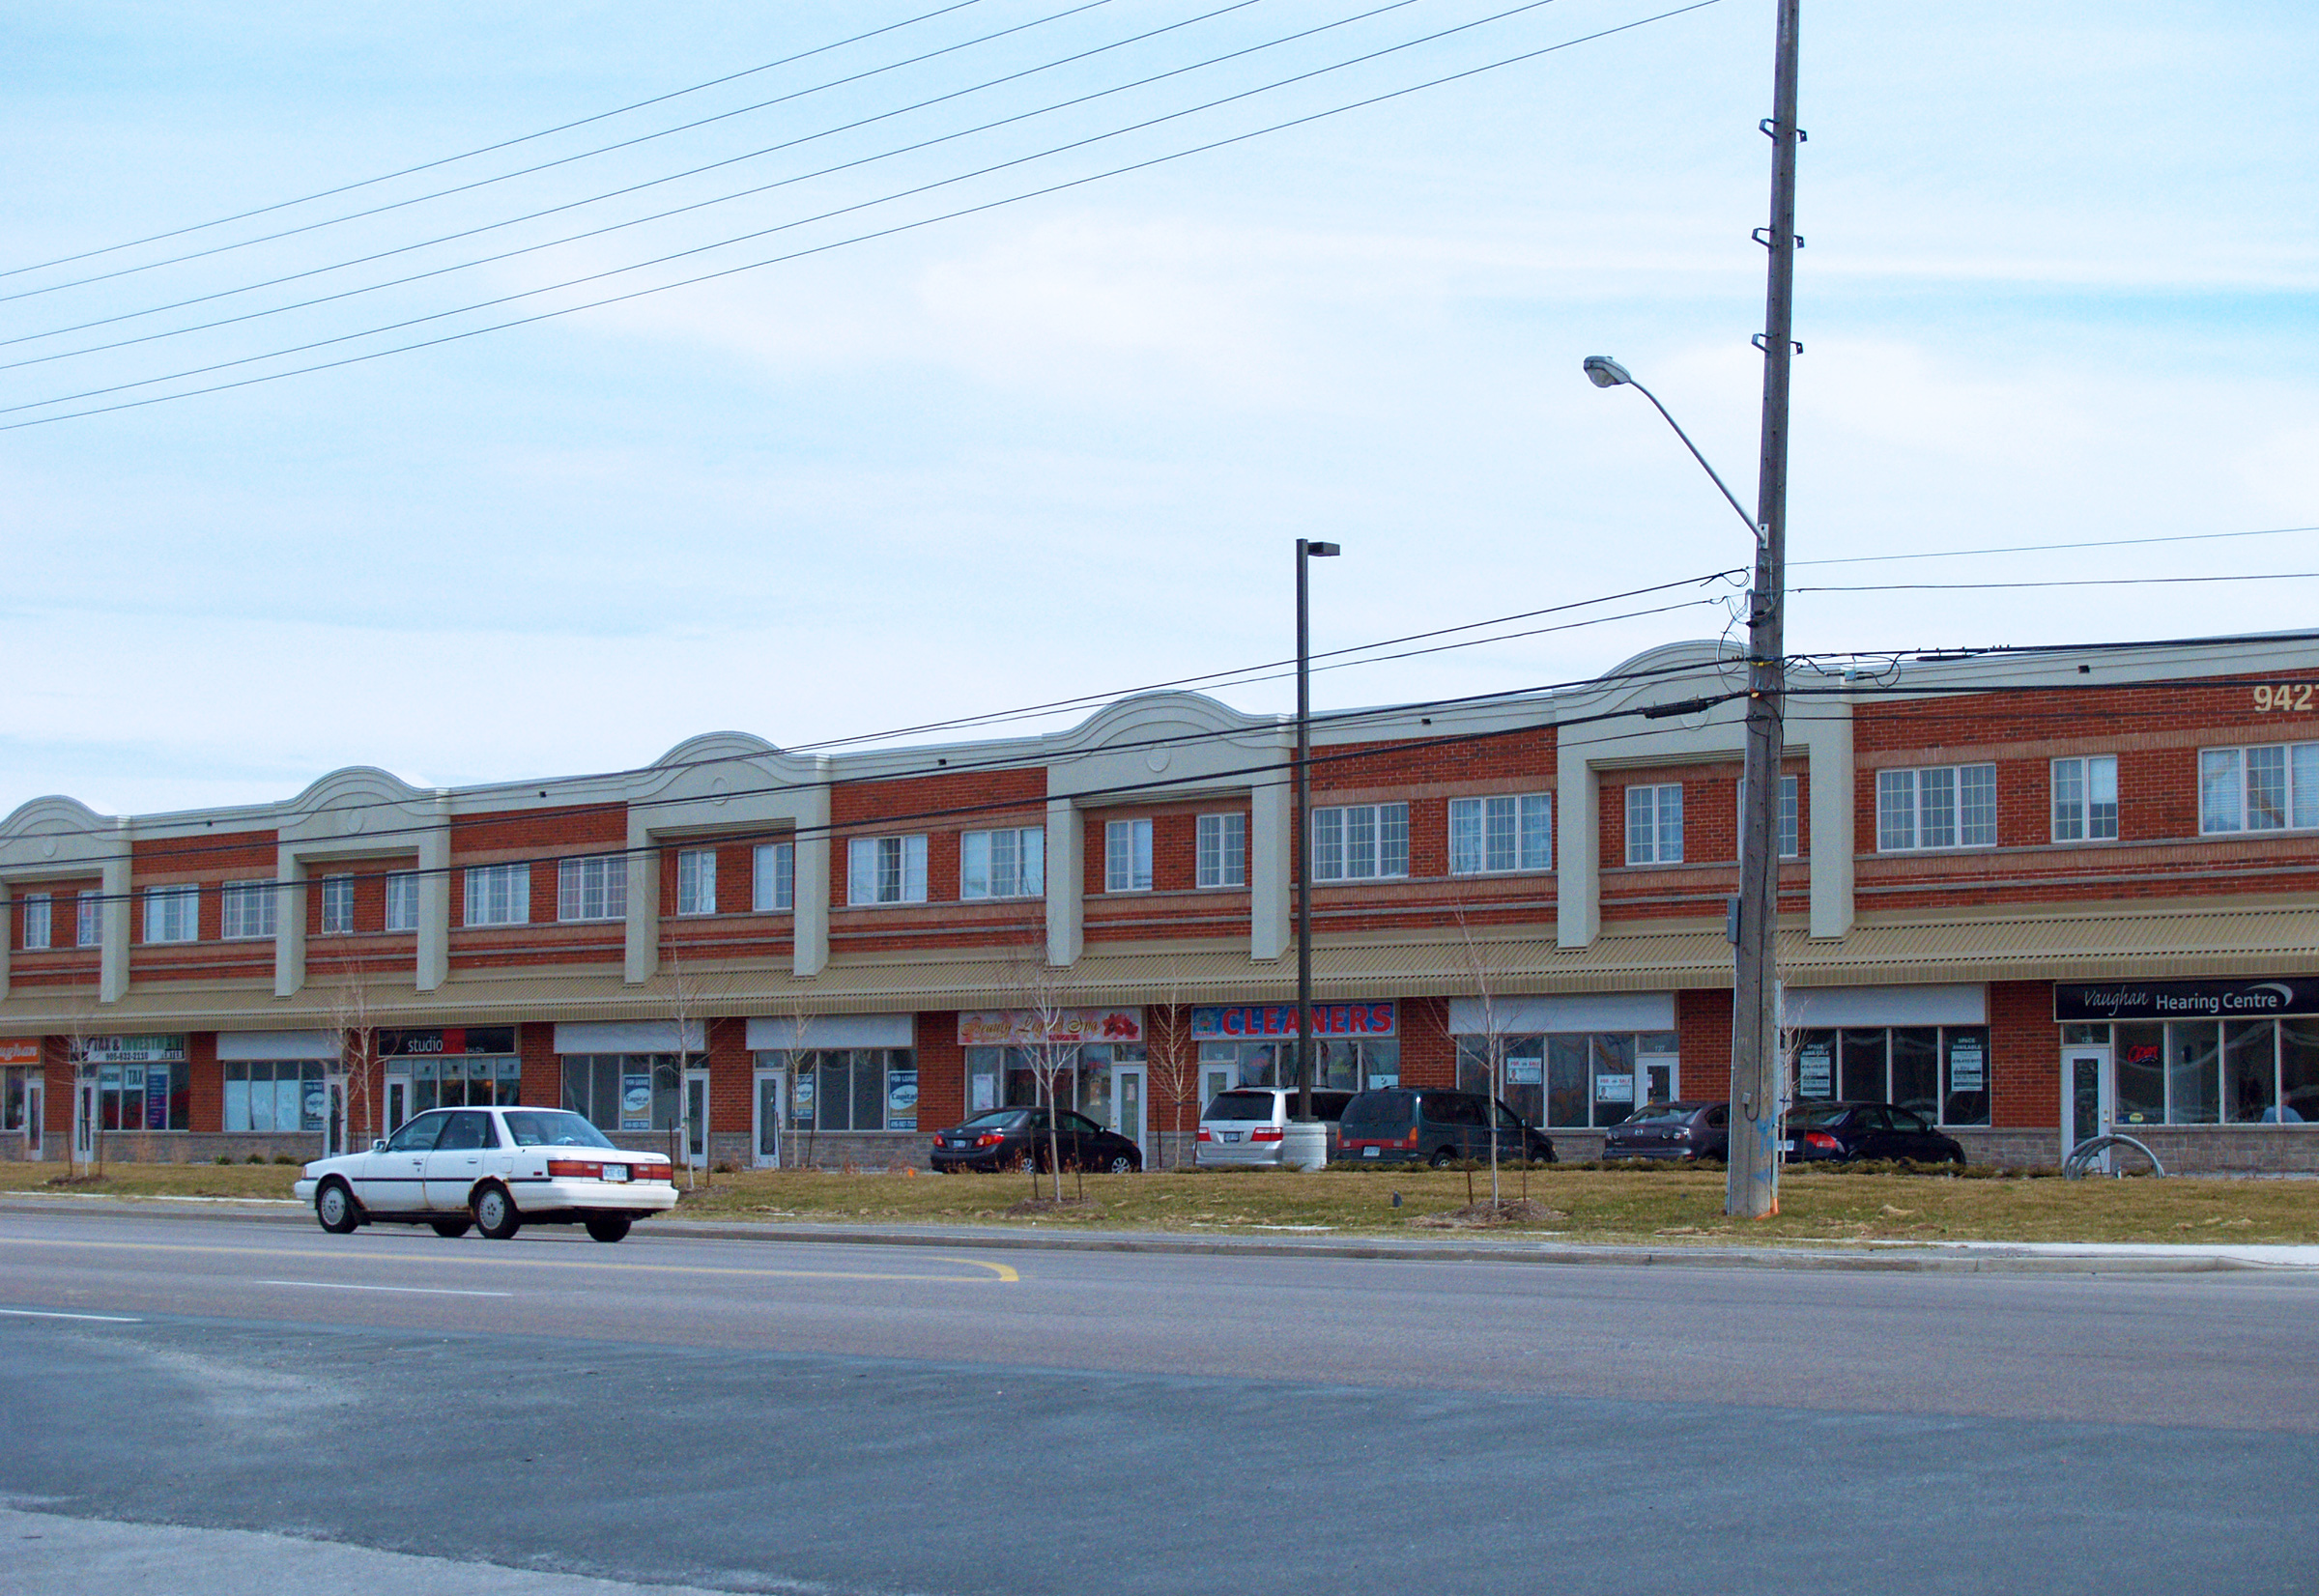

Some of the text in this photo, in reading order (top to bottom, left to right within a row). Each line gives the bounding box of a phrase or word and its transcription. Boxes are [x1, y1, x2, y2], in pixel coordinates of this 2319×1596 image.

[2084, 984, 2277, 1016] Vaughan Hearing Centre
[1067, 1015, 1098, 1036] Spa
[1222, 1005, 1391, 1035] CLEANERS
[407, 1036, 444, 1053] studio
[128, 1069, 143, 1085] TAX
